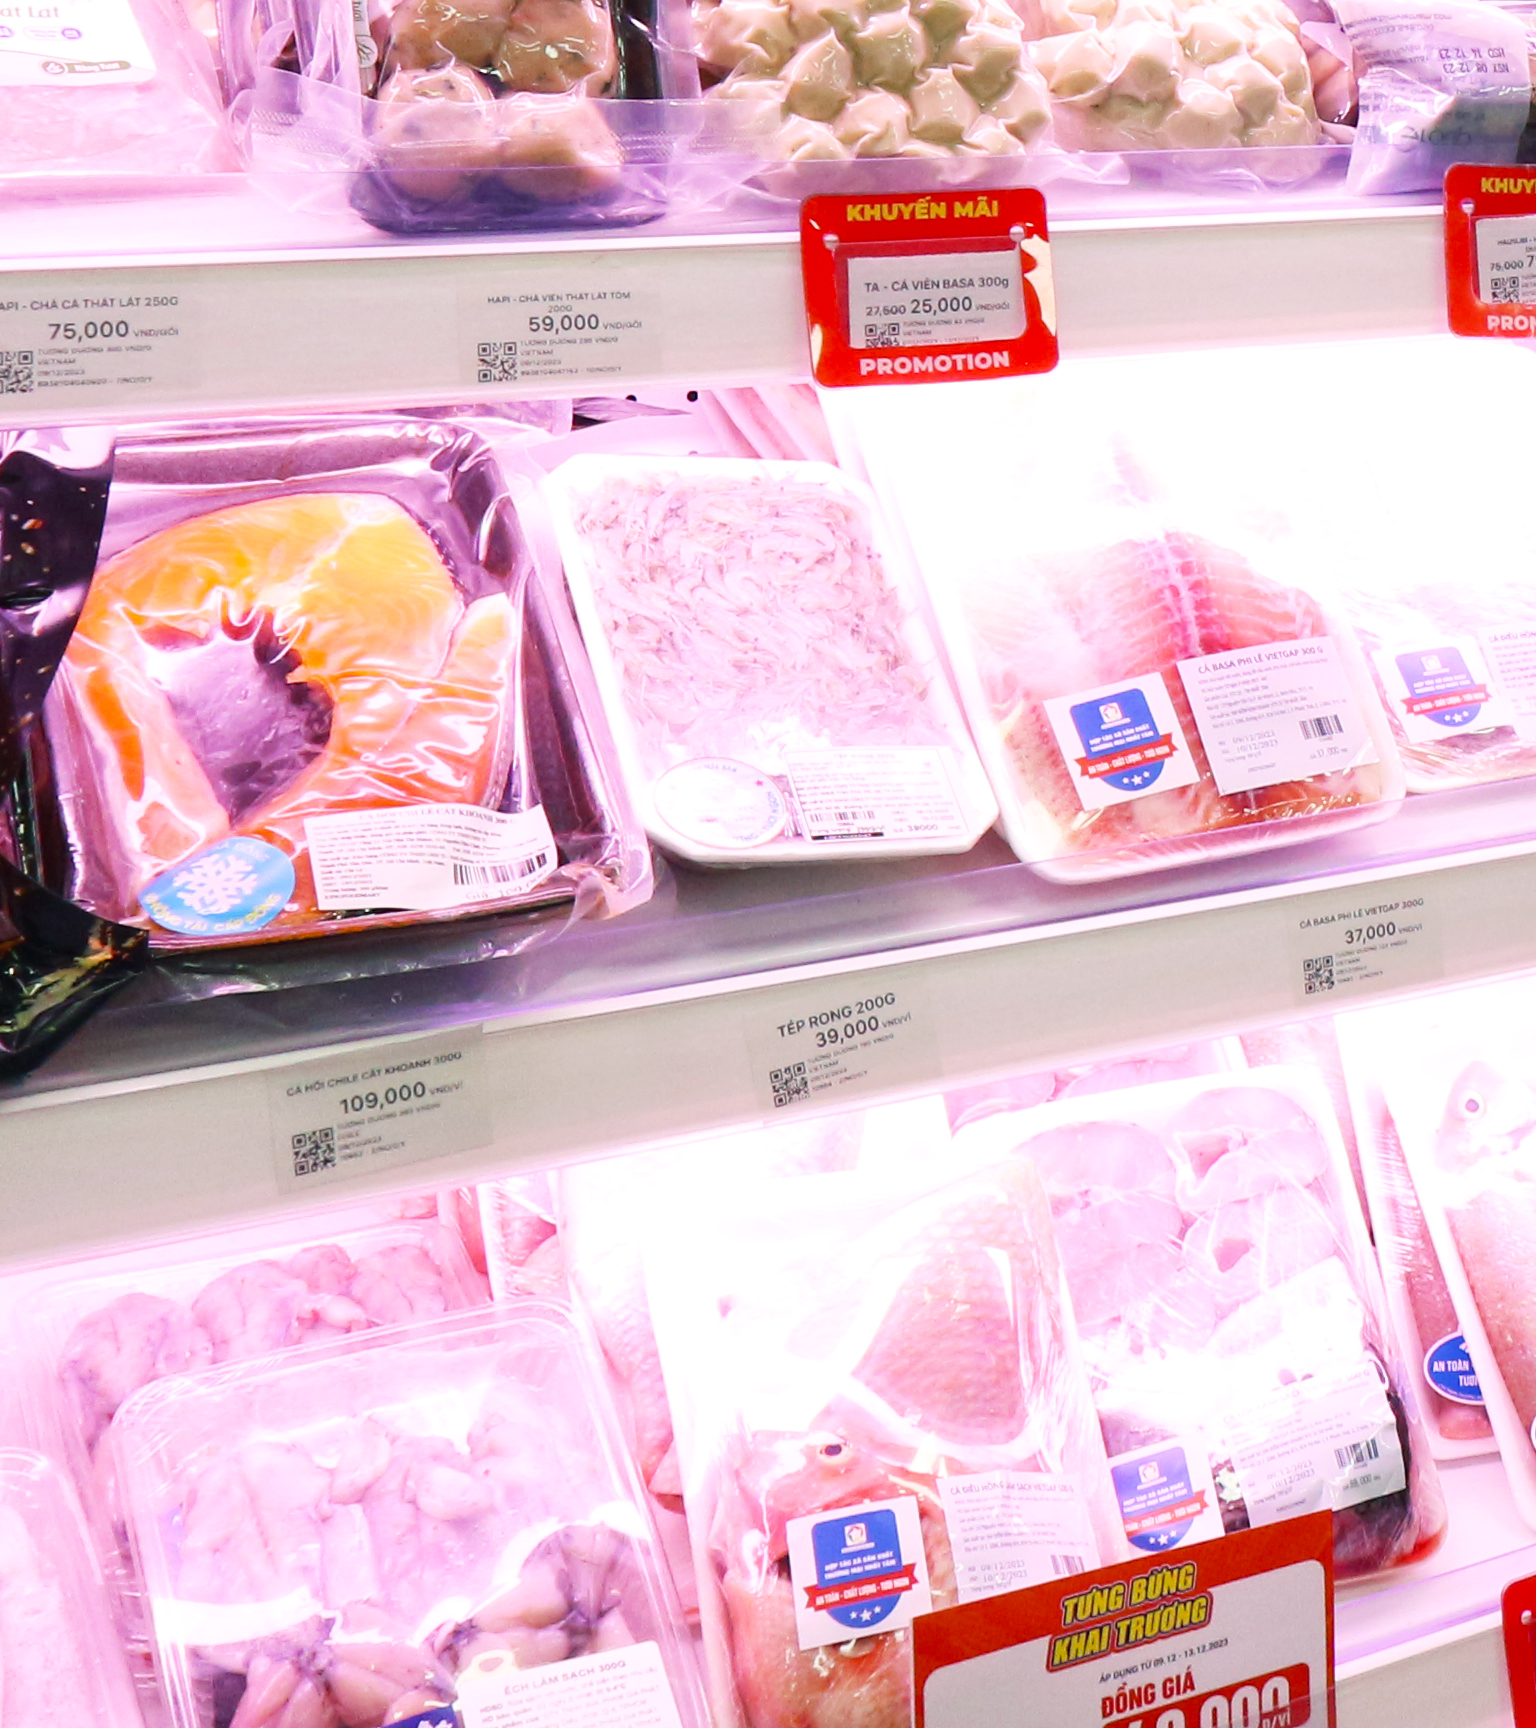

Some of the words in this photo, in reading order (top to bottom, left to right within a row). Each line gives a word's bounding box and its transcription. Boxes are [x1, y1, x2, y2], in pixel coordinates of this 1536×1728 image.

[846, 195, 948, 223] KHUYẾN
[952, 195, 1000, 219] MÃI
[942, 276, 976, 290] BASA
[977, 275, 1010, 291] 300g
[144, 295, 179, 308] 250G
[909, 295, 974, 317] 25,000
[48, 319, 130, 344] 75,000
[528, 313, 601, 336] 59,000
[858, 350, 1011, 377] PROMOTION
[1344, 920, 1397, 946] 37,000
[777, 1017, 806, 1039] TÉP
[808, 1005, 853, 1030] RONG
[854, 992, 897, 1016] 200G
[814, 1015, 880, 1049] 39,000
[339, 1080, 427, 1116] 109,000
[1432, 1360, 1445, 1373] AN
[1446, 1355, 1470, 1372] TOÀN
[1048, 1627, 1112, 1669] KHAI
[1113, 1593, 1213, 1649] TRƯƠNG
[1100, 1681, 1157, 1720] ĐỒNG
[1161, 1664, 1198, 1700] GIÁ
